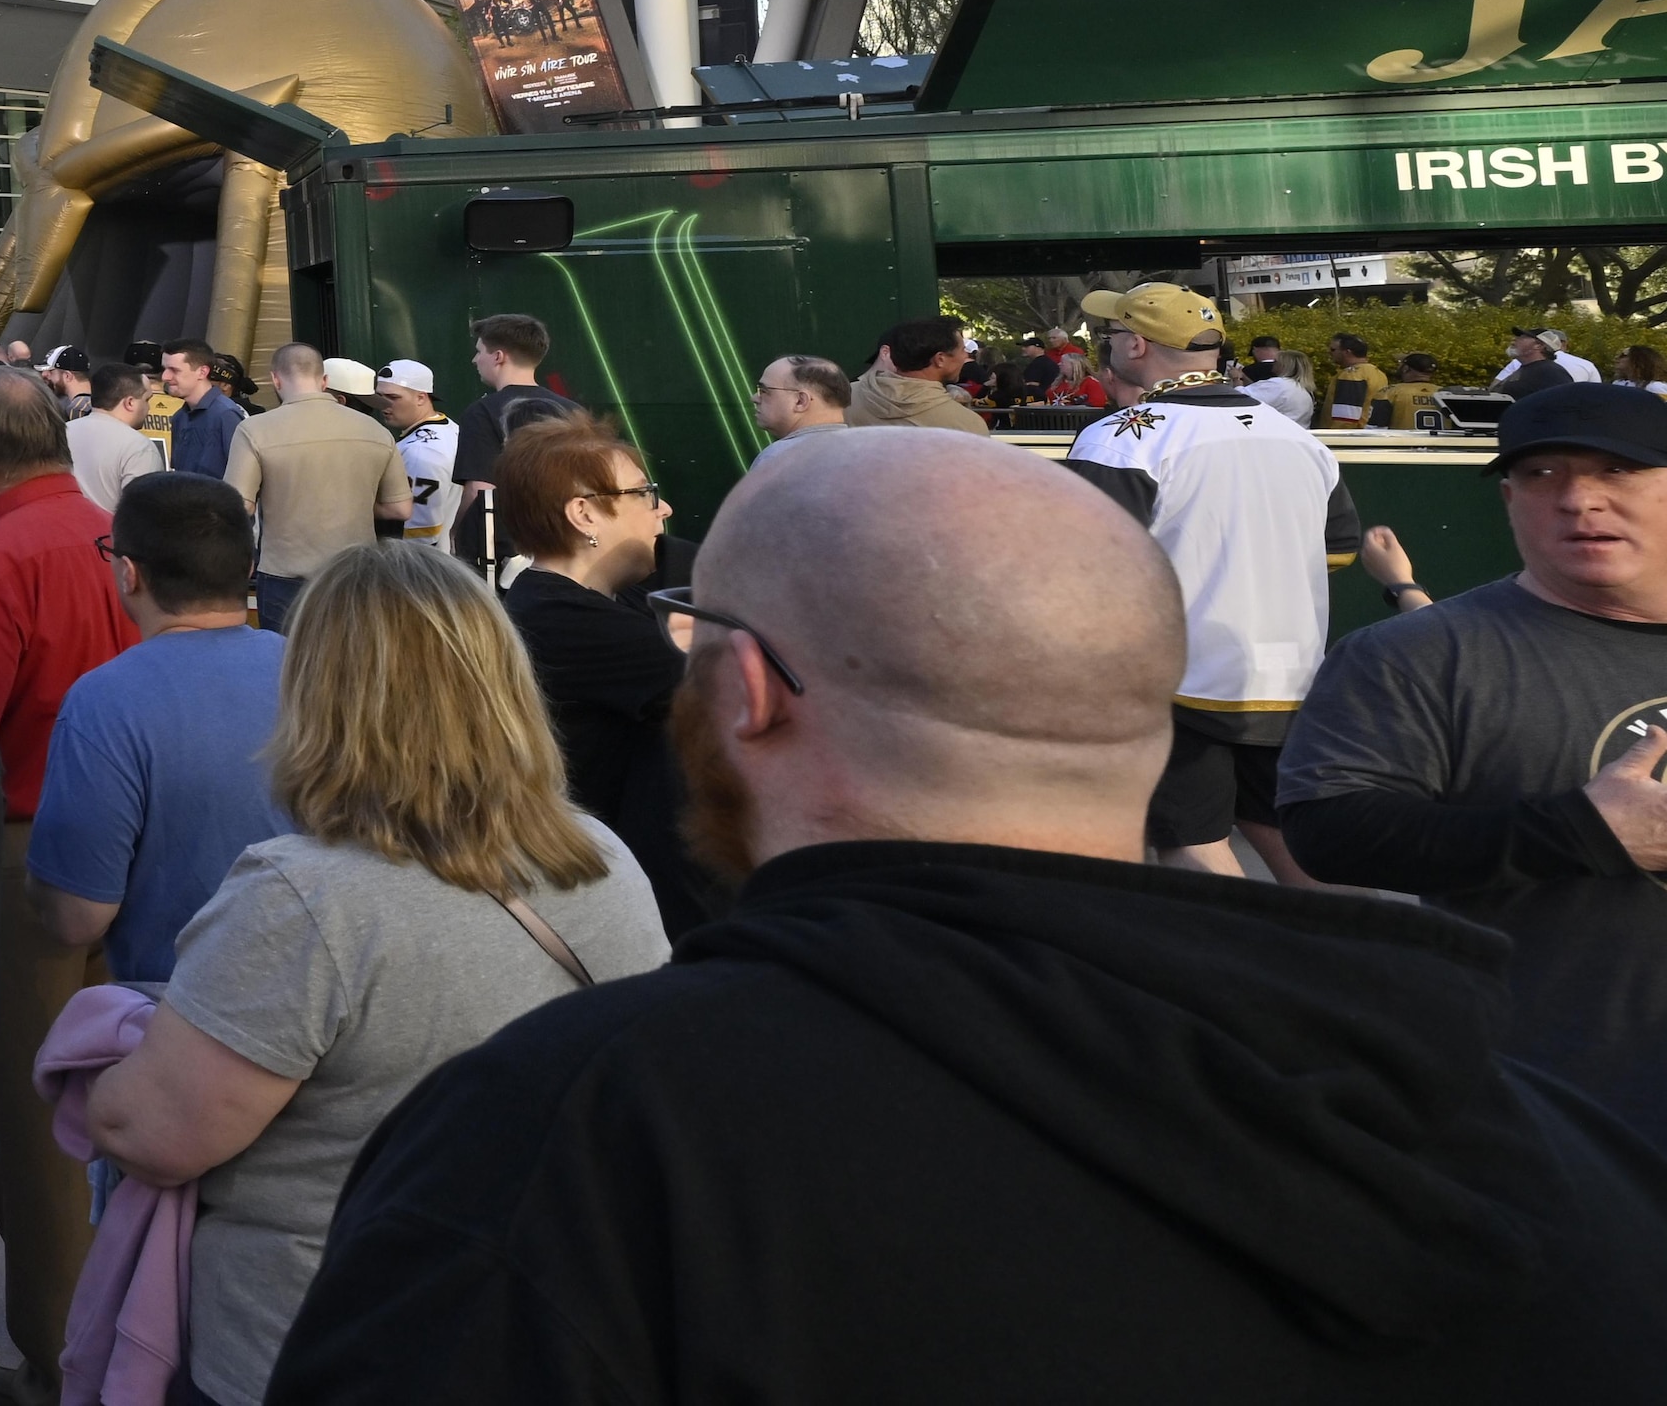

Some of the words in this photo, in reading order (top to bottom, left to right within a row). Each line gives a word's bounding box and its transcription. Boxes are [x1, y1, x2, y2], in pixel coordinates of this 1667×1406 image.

[541, 58, 567, 72] AIRE
[570, 53, 598, 67] TOUR
[1395, 145, 1588, 191] IRISH
[408, 476, 440, 505] 7
